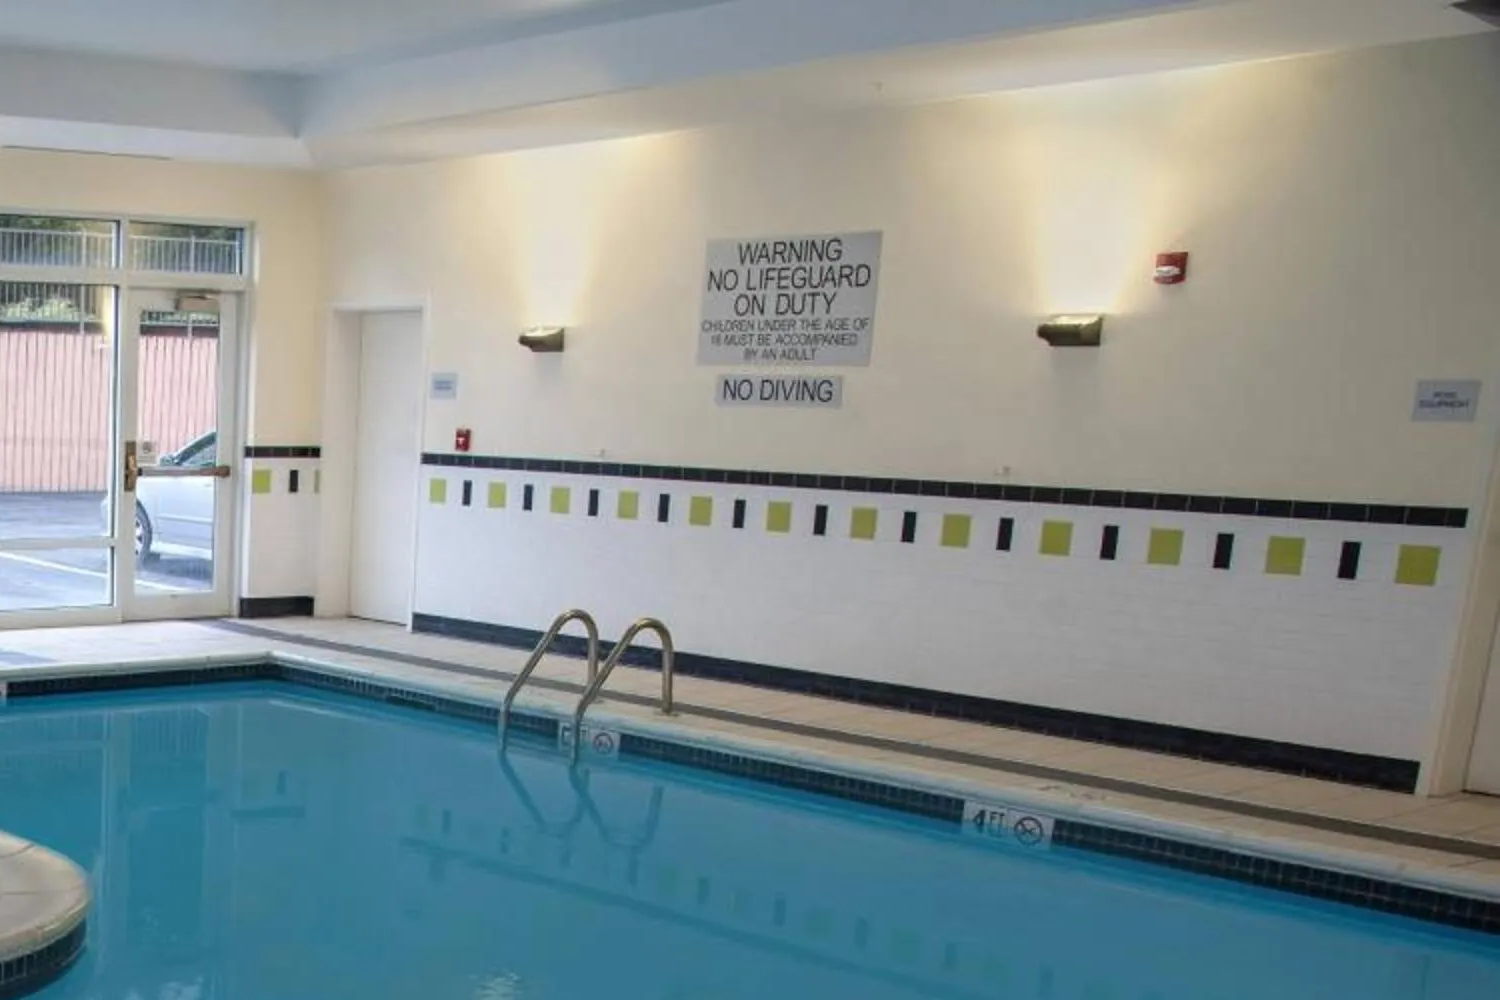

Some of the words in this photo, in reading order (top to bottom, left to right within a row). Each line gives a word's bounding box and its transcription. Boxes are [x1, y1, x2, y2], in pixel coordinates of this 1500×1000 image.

[738, 238, 843, 266] WARNING
[707, 269, 739, 292] NO
[746, 264, 872, 291] LIFEGUARD
[733, 294, 766, 317] ON
[775, 292, 837, 315] DUTY
[701, 319, 754, 332] CHILDREN
[757, 318, 797, 331] UNDER
[799, 318, 822, 331] THE
[852, 317, 870, 331] OF
[724, 334, 754, 347] MUST
[757, 333, 772, 346] BE
[775, 333, 859, 346] ACCOMPANIED
[761, 349, 777, 361] AN
[779, 347, 817, 361] ADULT
[722, 379, 753, 401] NO
[759, 379, 834, 403] DIVING
